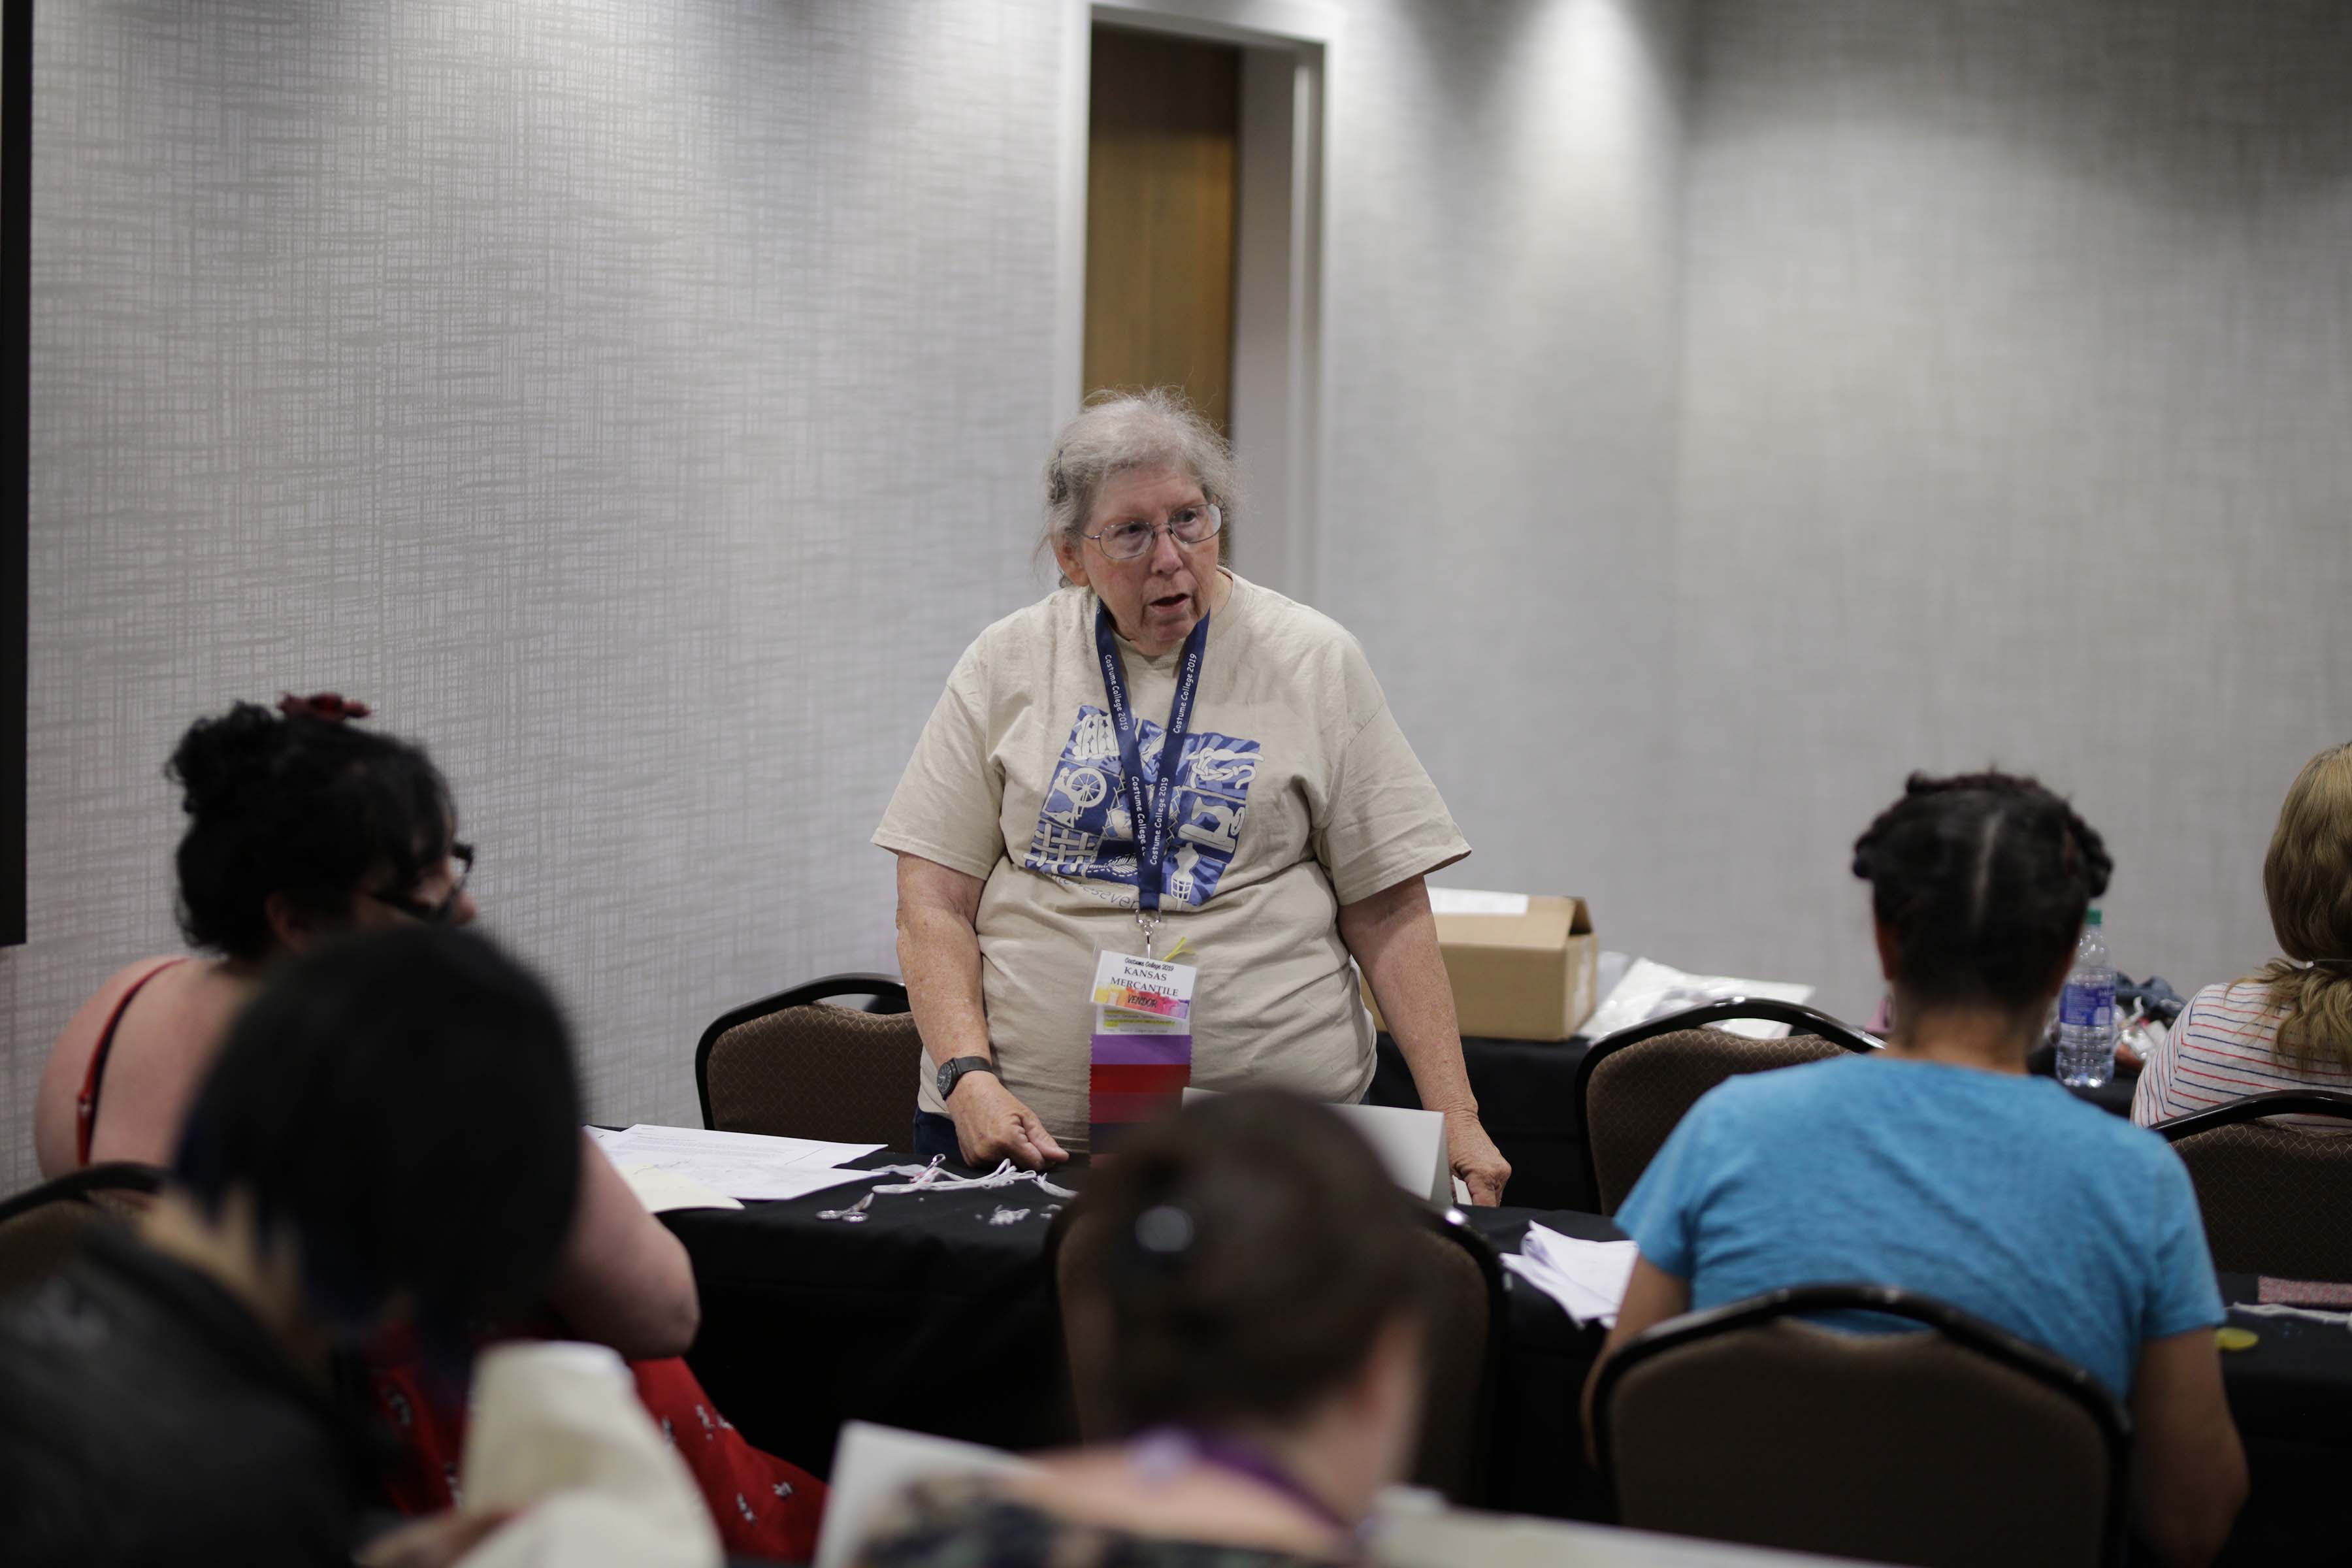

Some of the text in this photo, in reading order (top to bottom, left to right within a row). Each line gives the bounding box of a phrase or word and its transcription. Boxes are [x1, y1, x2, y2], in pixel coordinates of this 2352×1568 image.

[1105, 654, 1128, 730] Costume College 2019
[1173, 653, 1197, 734] Costume College 2019
[1132, 776, 1142, 812] Costume
[1137, 813, 1147, 845] College
[1150, 777, 1169, 865] Costume College 2019
[1124, 957, 1145, 967] Costume
[1145, 961, 1161, 970] College
[1124, 967, 1168, 981] KANSAS
[1110, 977, 1179, 997] MERCANTILE
[1128, 994, 1158, 1008] VENDOR
